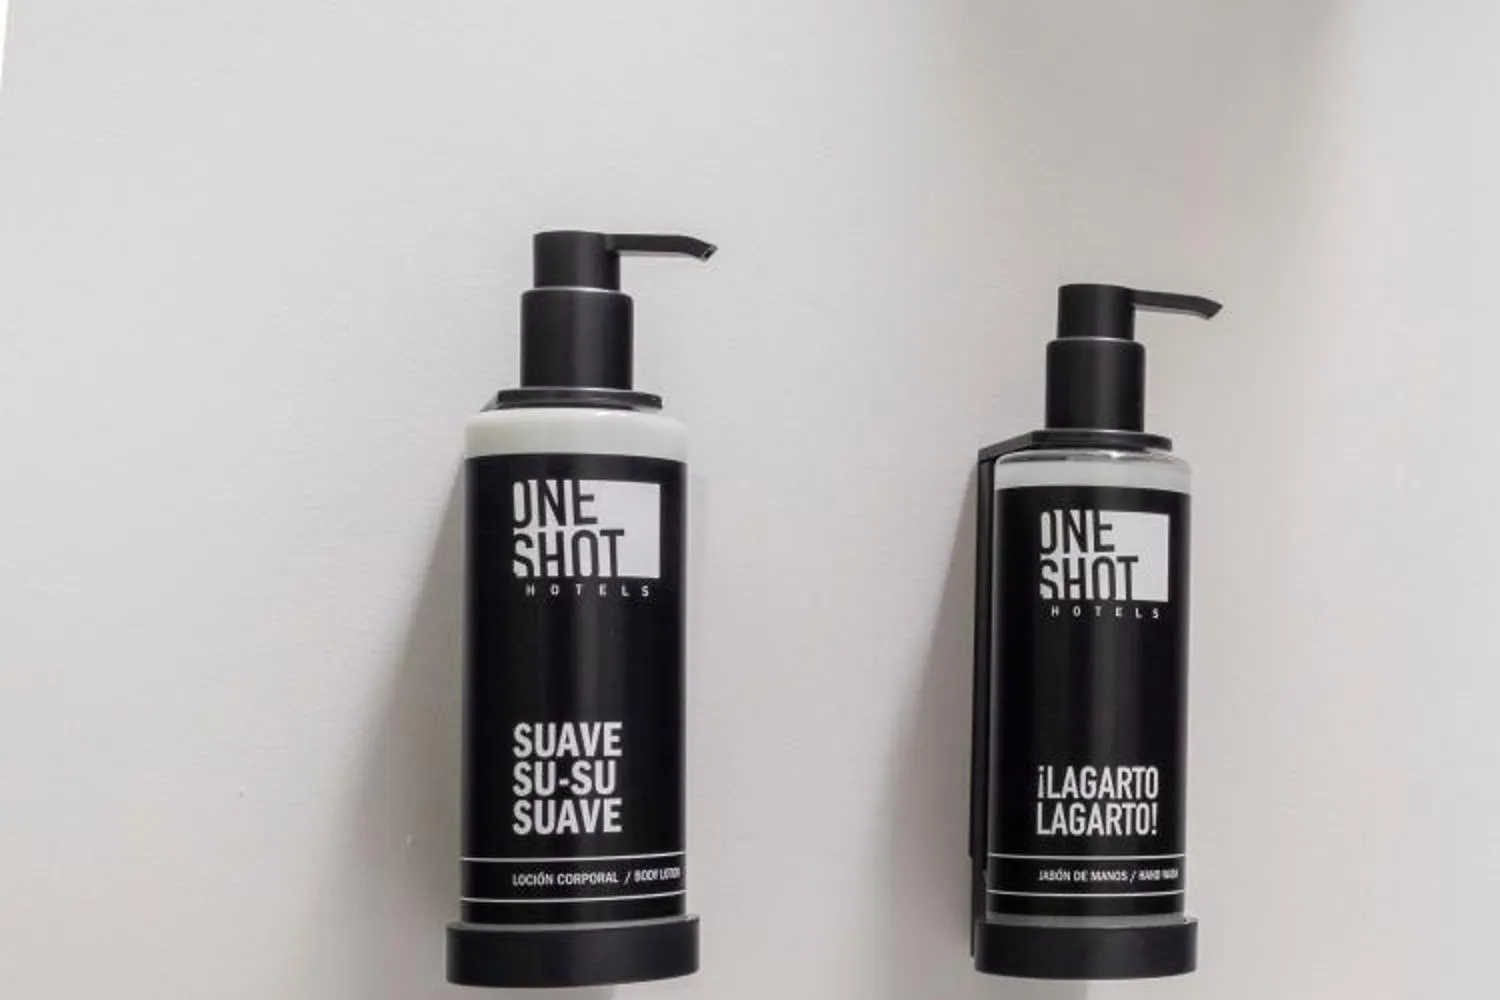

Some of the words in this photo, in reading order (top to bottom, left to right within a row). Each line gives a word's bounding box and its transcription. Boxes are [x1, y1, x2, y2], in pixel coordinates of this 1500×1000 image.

[511, 480, 598, 529] ONE
[1039, 509, 1116, 555] ONE
[511, 528, 625, 579] SHOT
[525, 583, 650, 598] HOTELS
[1039, 555, 1140, 601] SHOT
[1050, 605, 1160, 619] HOTELS
[512, 721, 623, 758] SUAVE
[512, 759, 617, 797] SU-SU
[1037, 765, 1159, 799] ¡LAGARTO
[512, 798, 623, 835] SUAVE
[1036, 801, 1159, 836] LAGARTO!
[512, 871, 553, 887] LOCIÓN
[557, 871, 620, 886] CORPORAL
[1038, 867, 1071, 881] JABÓN
[1073, 870, 1088, 881] DE
[1090, 870, 1128, 881] MANOS
